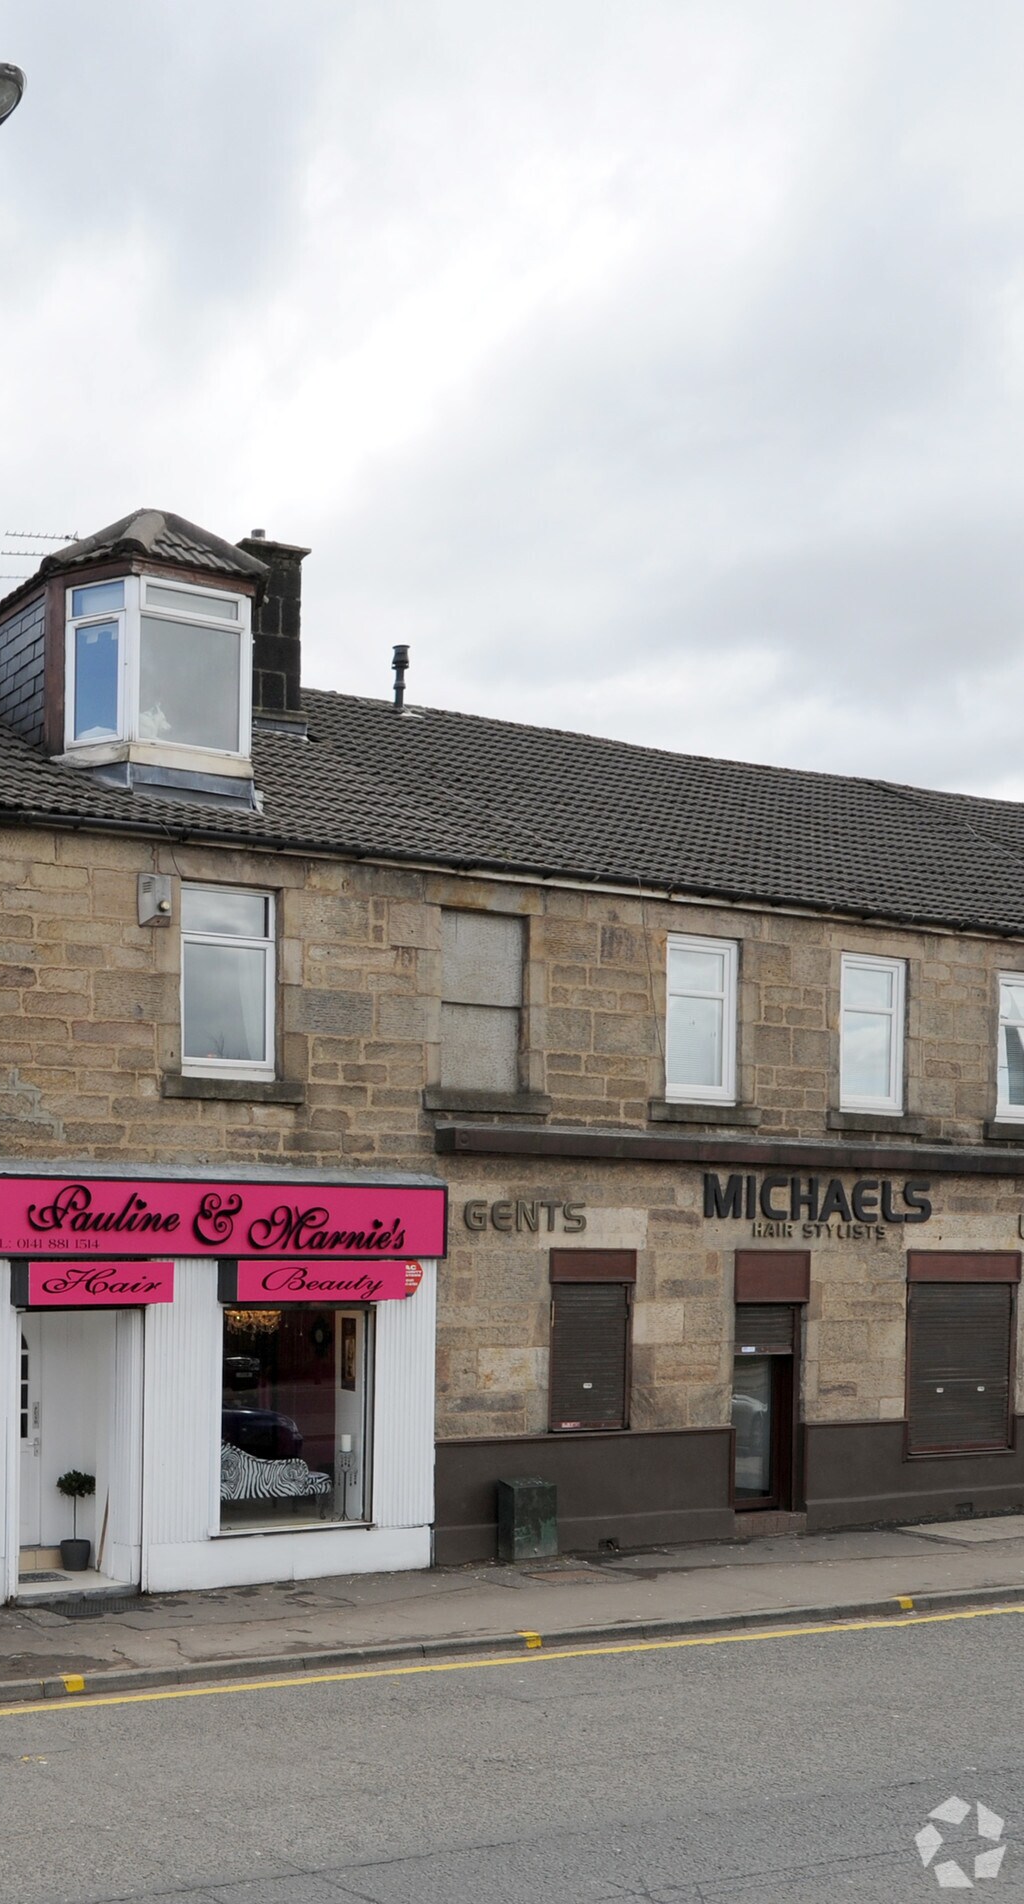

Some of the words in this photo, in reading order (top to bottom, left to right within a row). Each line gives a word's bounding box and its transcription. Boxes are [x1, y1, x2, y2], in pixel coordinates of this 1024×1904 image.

[703, 1173, 932, 1223] MICHAELS
[28, 1184, 181, 1232] Pauline
[193, 1192, 243, 1246] &
[247, 1205, 406, 1250] Marnie's
[463, 1199, 588, 1233] GENTS
[751, 1221, 795, 1238] HAIR
[801, 1223, 888, 1241] STYLISTS
[17, 1238, 43, 1249] 0141
[48, 1238, 70, 1249] 881
[75, 1238, 101, 1249] 1514
[41, 1268, 163, 1296] Hair
[261, 1267, 384, 1300] Beauty
